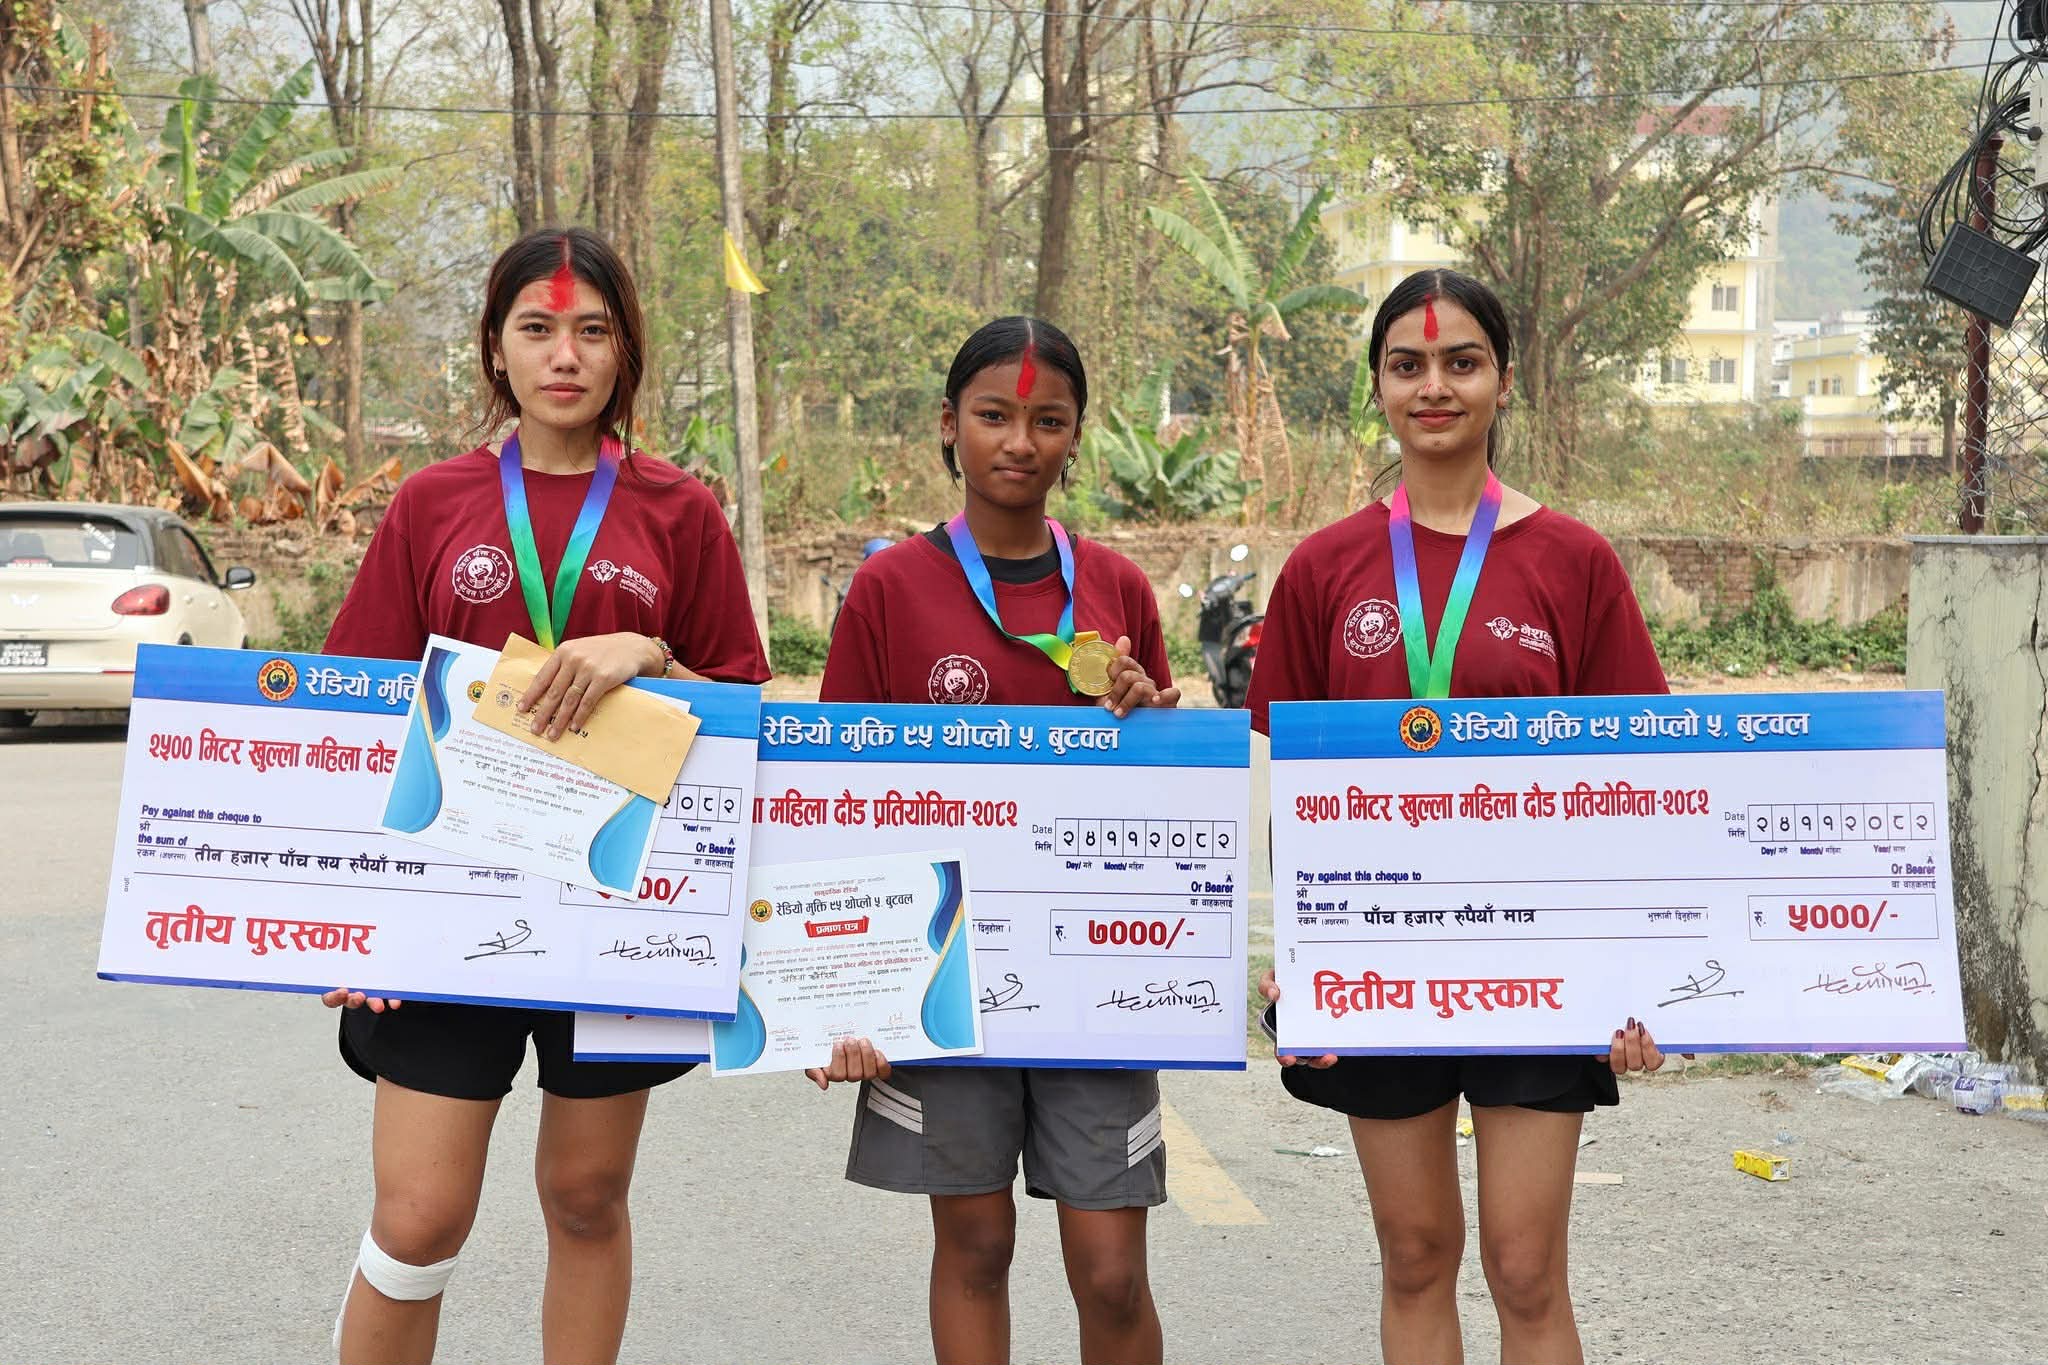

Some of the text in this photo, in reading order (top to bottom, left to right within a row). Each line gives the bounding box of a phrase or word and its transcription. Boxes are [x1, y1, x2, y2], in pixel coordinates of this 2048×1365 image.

[306, 668, 371, 696] रेडियो
[1450, 712, 1518, 740] रेडियो
[1528, 711, 1582, 744] मुक्ति
[1630, 709, 1699, 736] थोप्लो
[1738, 714, 1809, 741] बुटवल
[764, 716, 833, 744] रेडियो
[841, 717, 896, 751] मुक्ति
[943, 719, 1012, 747] थोप्लो
[1049, 728, 1120, 754] बुटवल
[199, 727, 242, 765] मिटर
[248, 740, 301, 773] खुल्ला
[305, 735, 362, 773] महिला
[769, 788, 828, 827] महिला
[833, 789, 867, 826] दौड
[1346, 785, 1393, 822] मिटर
[1398, 793, 1454, 828] खुल्ला
[1459, 783, 1518, 822] महिला
[1523, 783, 1557, 819] दौड
[142, 805, 261, 824] Pay against this cheque to
[1725, 812, 1745, 820] Date
[139, 821, 151, 831] श्री
[683, 824, 699, 832] Year/
[1032, 825, 1052, 833] Date
[1728, 828, 1746, 837] मिति
[138, 833, 188, 846] the sum of
[696, 842, 735, 855] Or Bearer
[1035, 841, 1052, 850] मिति
[1800, 847, 1823, 855] Month/
[1873, 845, 1891, 853] Year/
[1761, 847, 1776, 856] Day/
[137, 849, 156, 858] रकम
[194, 844, 224, 861] तीन
[231, 851, 271, 868] हजार
[278, 847, 309, 868] पाँच
[316, 855, 342, 871] सय
[349, 853, 389, 874] रुपैयाँ
[394, 862, 427, 876] मात्र
[704, 858, 734, 869] वाहकलाई
[1066, 861, 1081, 870] Day/
[1104, 862, 1127, 870] Month/
[1176, 862, 1192, 870] Year/
[1891, 864, 1935, 874] Or Bearer
[1297, 871, 1421, 883] Pay against this cheque to
[1191, 881, 1234, 893] Or Bearer
[1891, 879, 1936, 889] वा वाहकलाई
[1296, 887, 1308, 898] श्री
[777, 901, 802, 915] रेडियो
[806, 899, 826, 915] मुक्ति
[845, 895, 871, 909] थोप्लो
[886, 894, 912, 908] बुटवल
[1201, 897, 1233, 908] वाहकलाई
[1297, 900, 1348, 911] the sum of
[1297, 917, 1317, 926] रकम
[1364, 904, 1396, 926] पाँच
[1404, 910, 1446, 928] हजार
[1454, 903, 1495, 927] रुपैयाँ
[1502, 909, 1536, 924] मात्र
[145, 904, 376, 956] तृतीय पुरस्कार
[1313, 969, 1563, 1019] द्वितीय पुरस्कार
